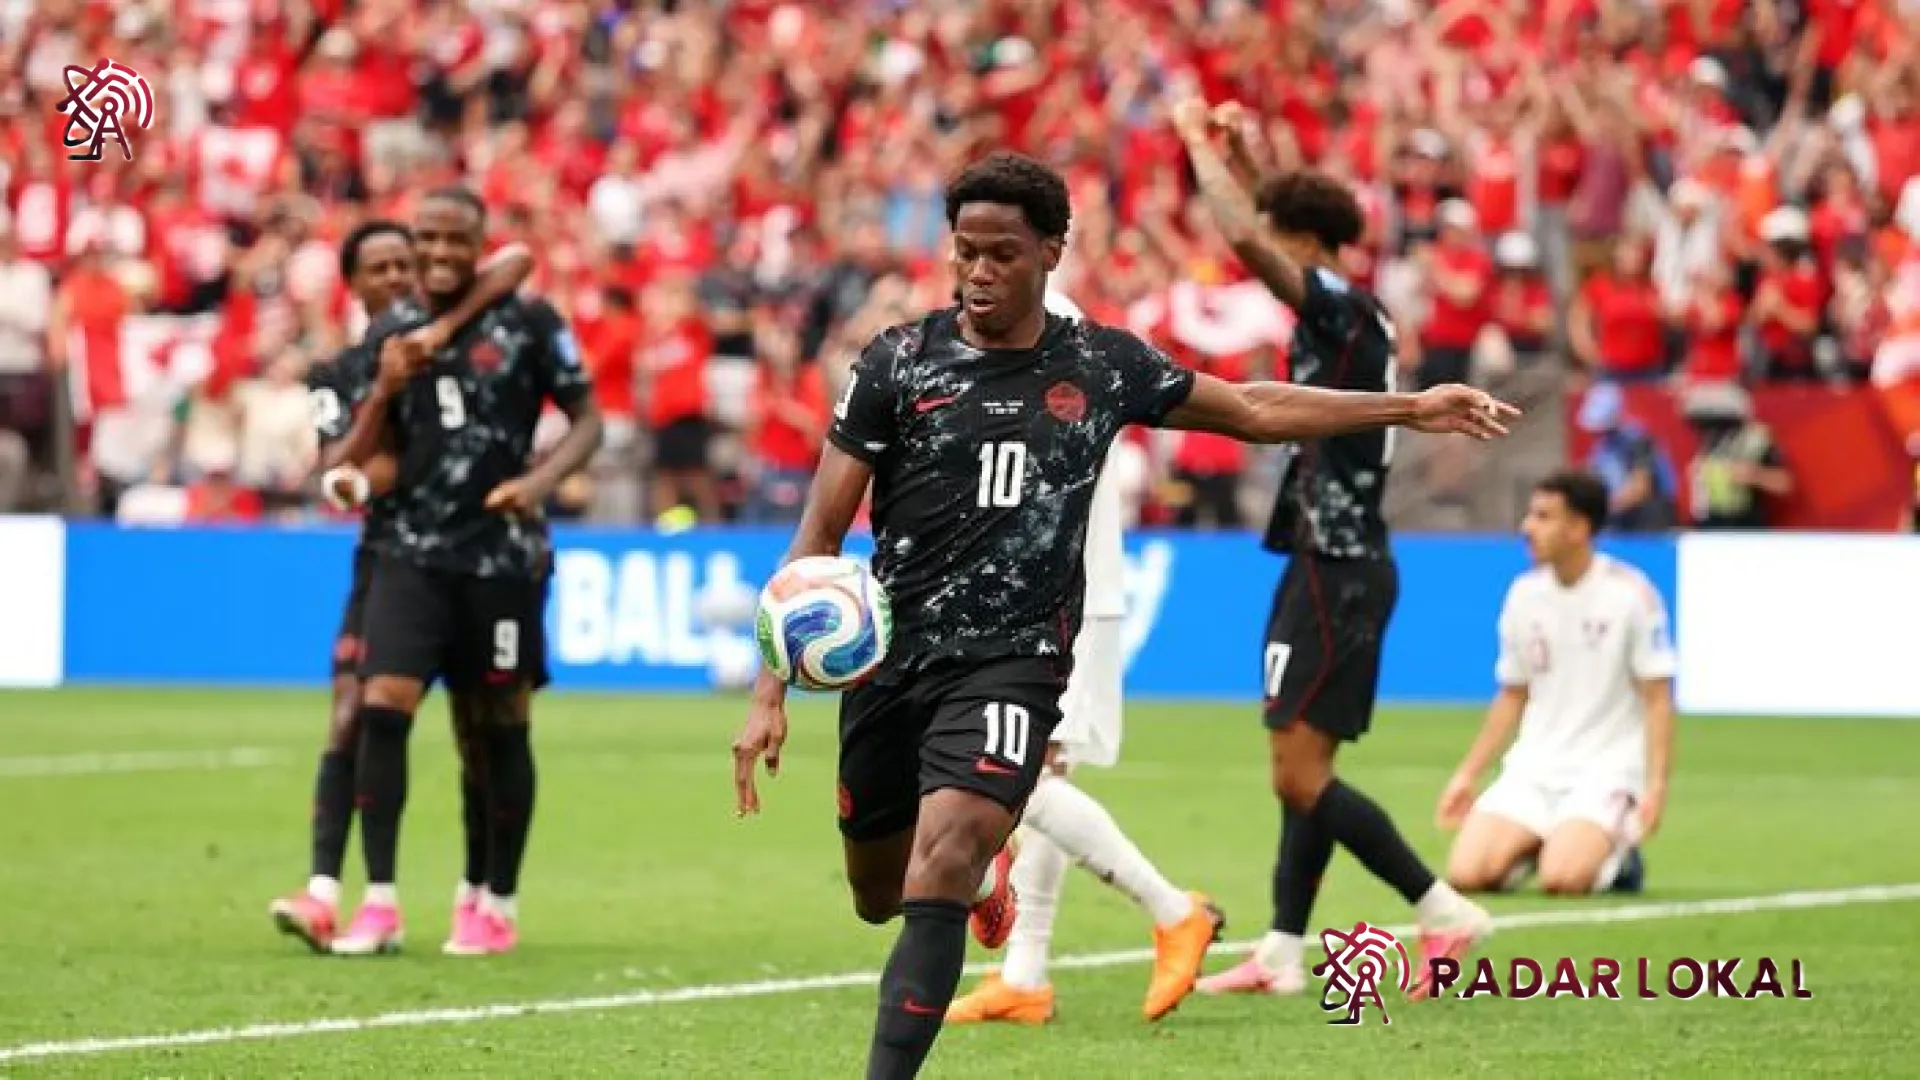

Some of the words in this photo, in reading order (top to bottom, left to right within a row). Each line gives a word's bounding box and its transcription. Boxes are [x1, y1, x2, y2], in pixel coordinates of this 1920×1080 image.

[435, 375, 467, 430] 9
[977, 441, 1027, 508] 10
[494, 619, 520, 670] 9
[982, 702, 1030, 766] 10
